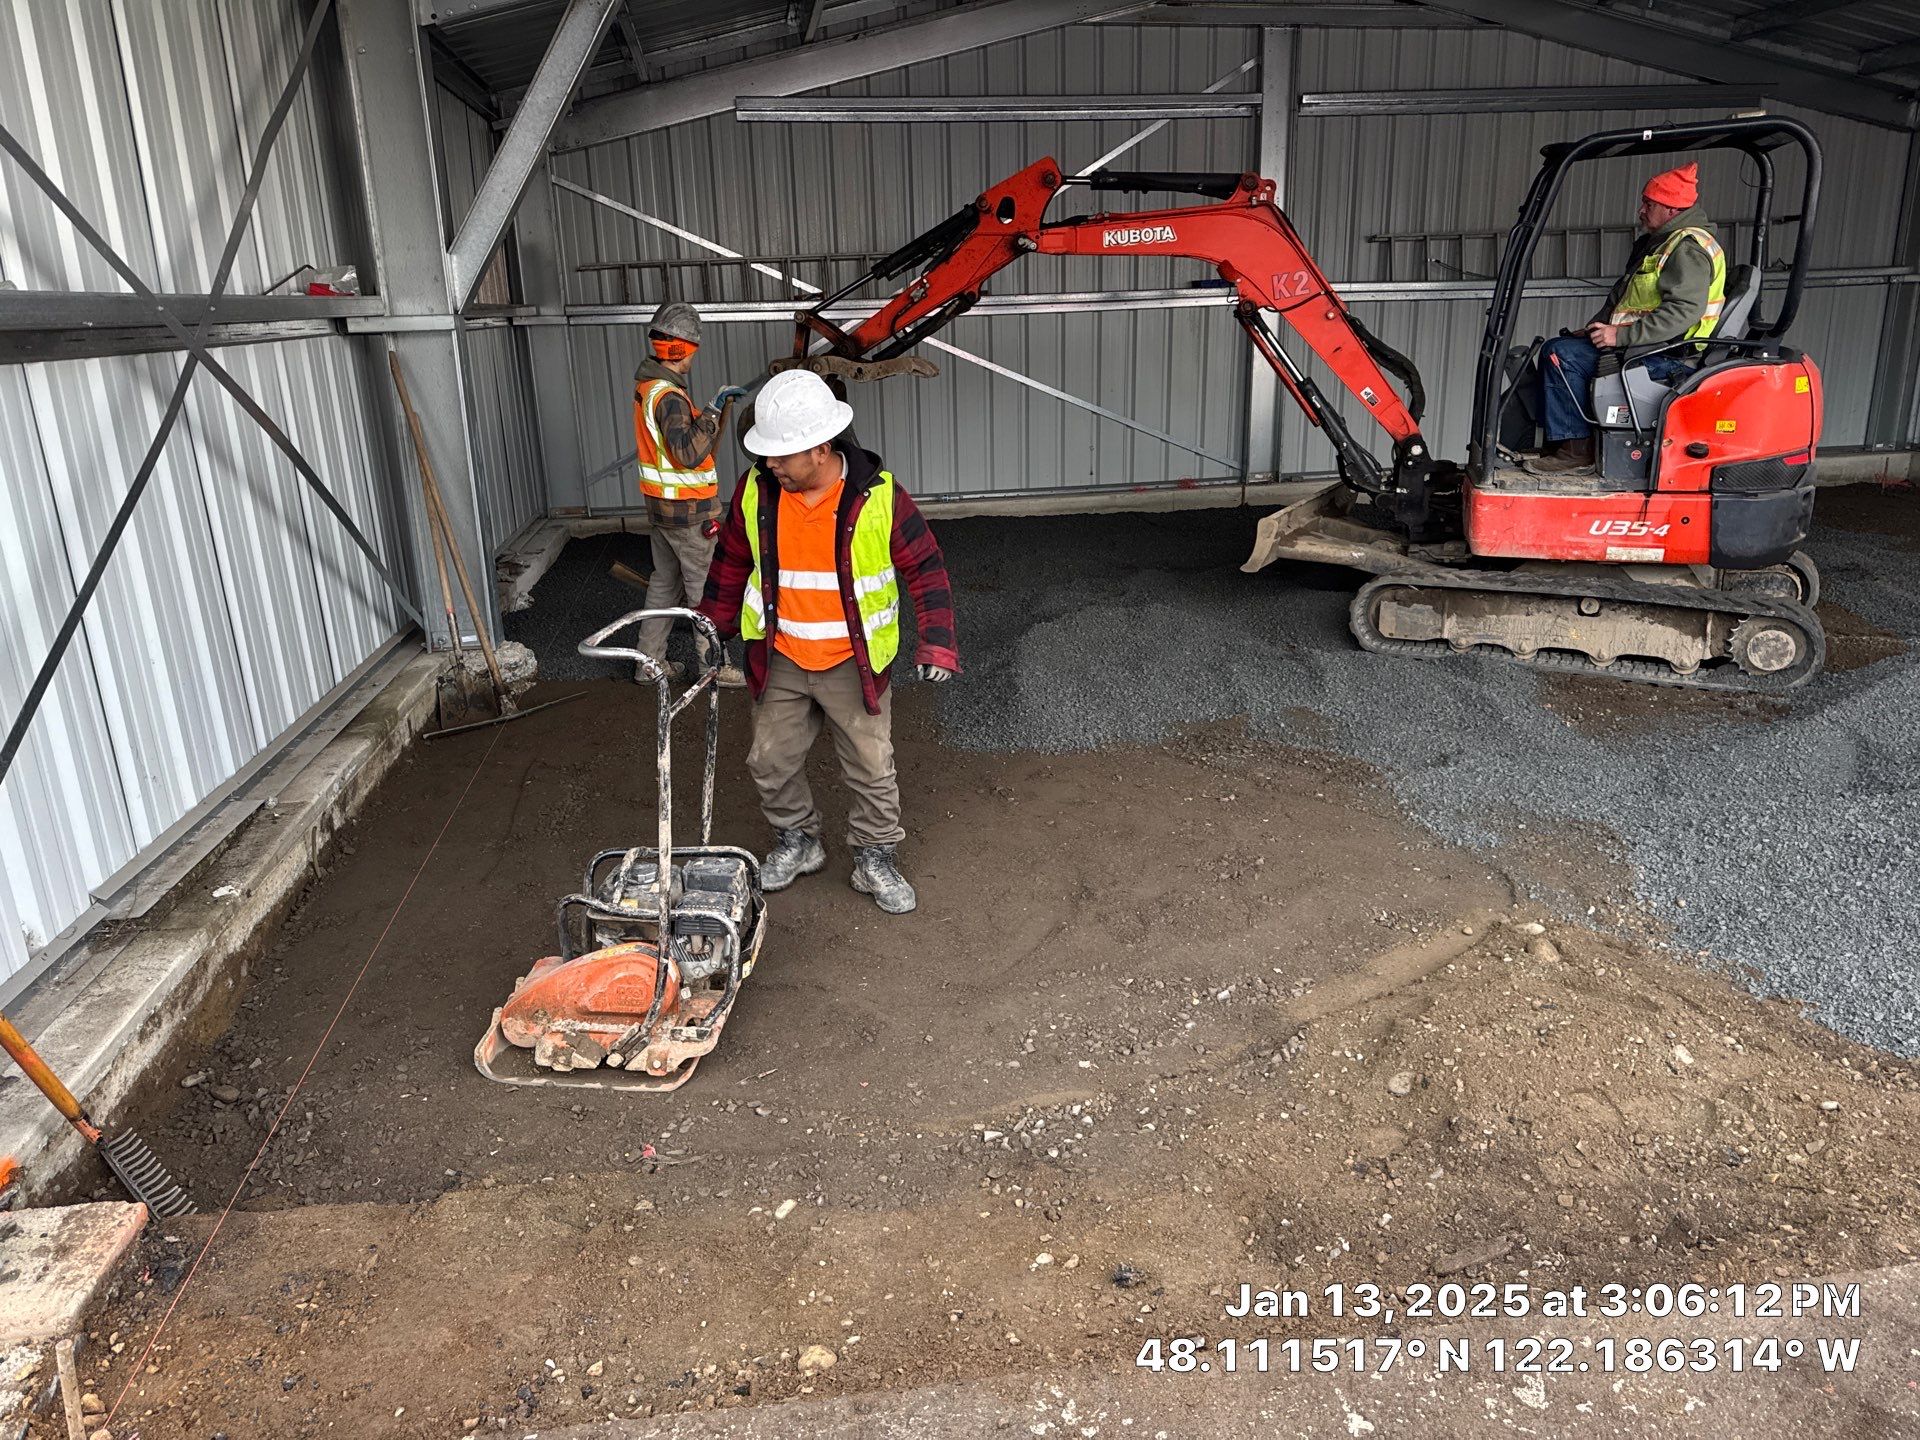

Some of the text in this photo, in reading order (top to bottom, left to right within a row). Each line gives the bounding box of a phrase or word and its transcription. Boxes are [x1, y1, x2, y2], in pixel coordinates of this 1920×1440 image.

[1104, 226, 1177, 247] KUBOTA
[1272, 271, 1310, 300] K2
[1589, 520, 1671, 536] U35-4
